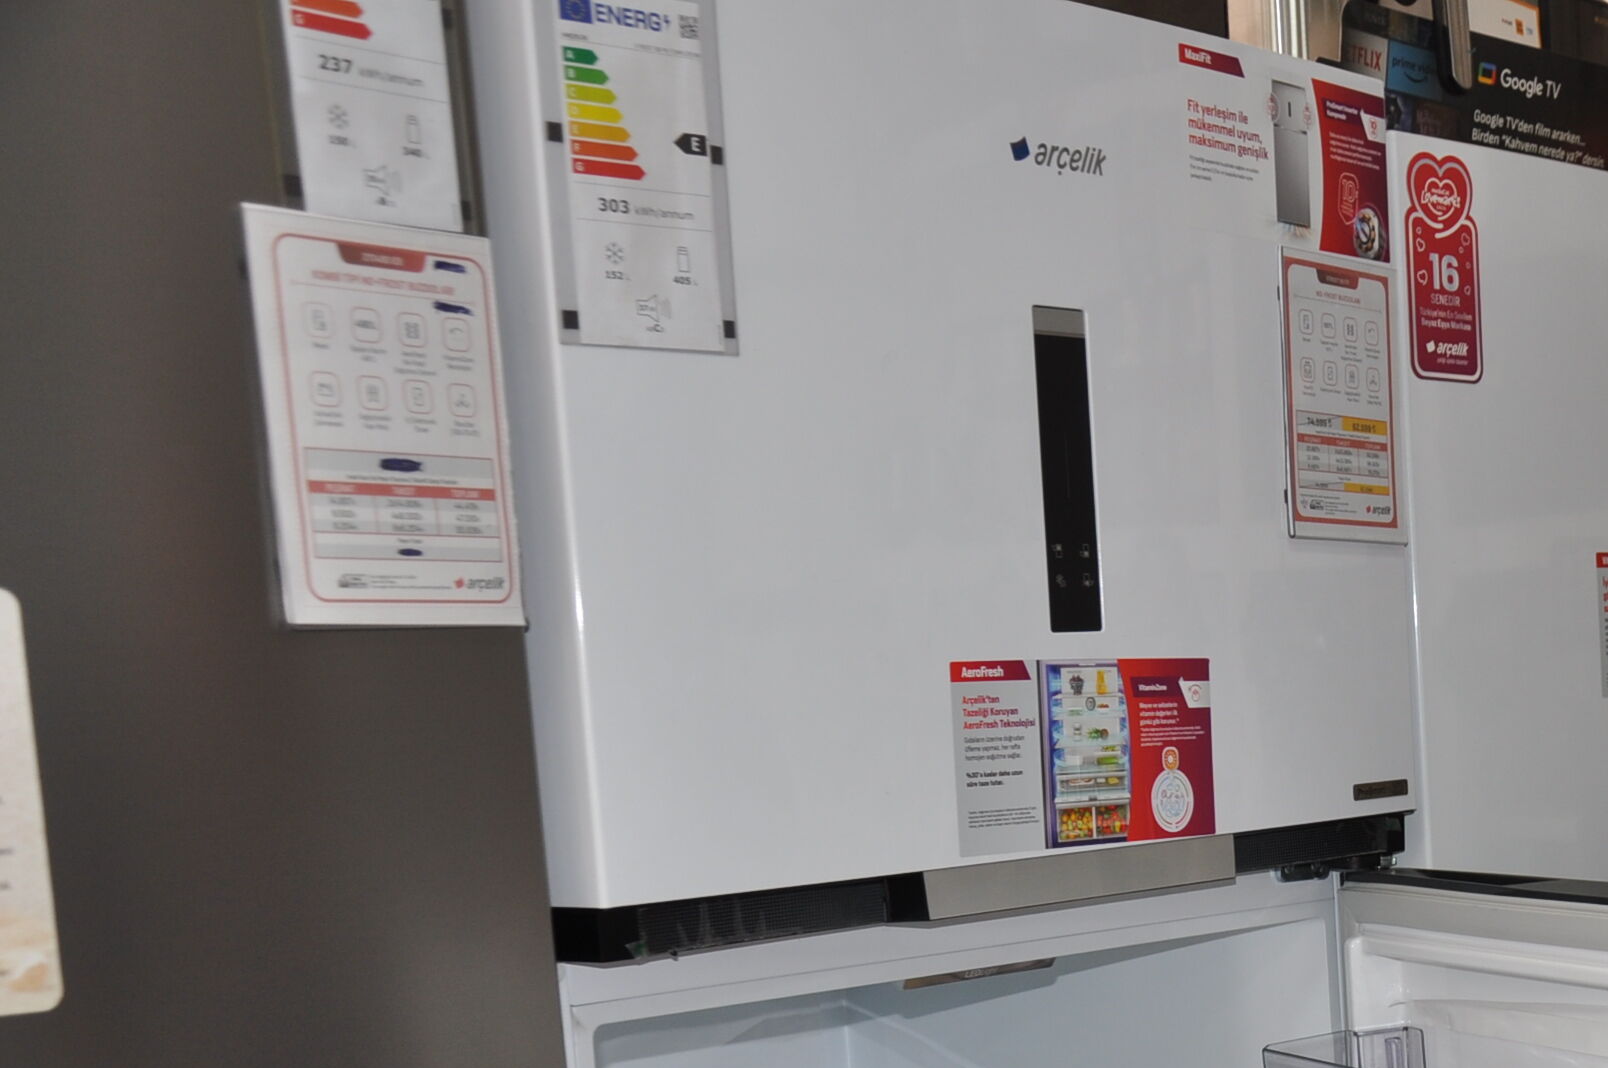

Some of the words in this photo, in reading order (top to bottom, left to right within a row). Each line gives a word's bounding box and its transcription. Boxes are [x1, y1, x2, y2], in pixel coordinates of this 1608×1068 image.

[318, 54, 352, 73] 237
[1500, 68, 1543, 98] Google
[1546, 81, 1561, 99] TV
[1187, 99, 1199, 113] Fit
[1200, 103, 1237, 123] yerleşim
[1238, 111, 1249, 124] ile
[1474, 109, 1504, 129] Google
[1505, 117, 1534, 133] TV'den
[1535, 123, 1550, 138] film
[1188, 117, 1236, 138] mükemmel
[1237, 129, 1263, 144] uyum,
[690, 136, 702, 152] E
[1188, 133, 1236, 153] maksimum
[1237, 145, 1269, 161] genişlik
[1472, 128, 1500, 145] Birden
[1539, 145, 1564, 159] nerede
[1034, 140, 1107, 178] arçelik
[597, 197, 630, 214] 303
[1429, 252, 1459, 292] 16
[1437, 342, 1469, 358] arçelik
[961, 665, 1004, 678] AeroFresh
[963, 707, 989, 718] Tazeliği
[990, 707, 1019, 717] Koruyan
[963, 720, 998, 729] AeroFresh
[999, 718, 1036, 728] Teknolojisi
